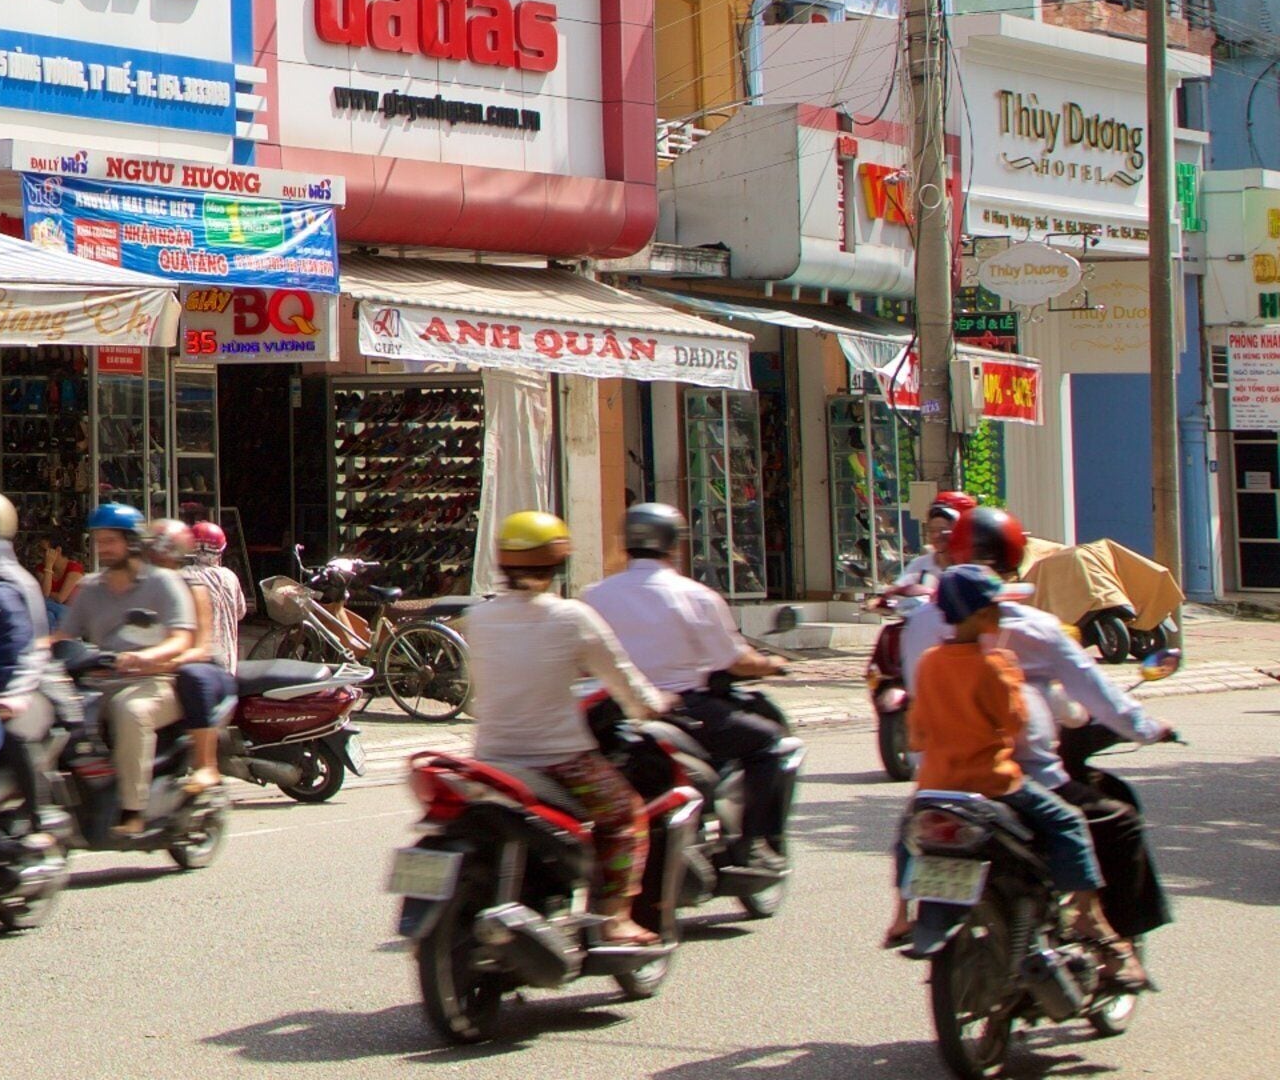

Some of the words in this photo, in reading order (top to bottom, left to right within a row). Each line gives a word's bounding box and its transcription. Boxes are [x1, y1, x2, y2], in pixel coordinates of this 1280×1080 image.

[994, 89, 1061, 154] Thùy
[1062, 102, 1144, 170] Dương
[48, 156, 60, 173] LÝ
[182, 165, 262, 195] HƯƠNG
[1039, 157, 1106, 183] HOTEL
[990, 264, 1021, 279] Thùy
[1023, 263, 1069, 279] Dương
[233, 287, 321, 337] BQ
[185, 329, 217, 355] 35
[419, 316, 522, 352] ANH
[534, 328, 659, 363] QUÂN
[1229, 331, 1258, 349] PHÒNG
[674, 345, 739, 370] DADAS
